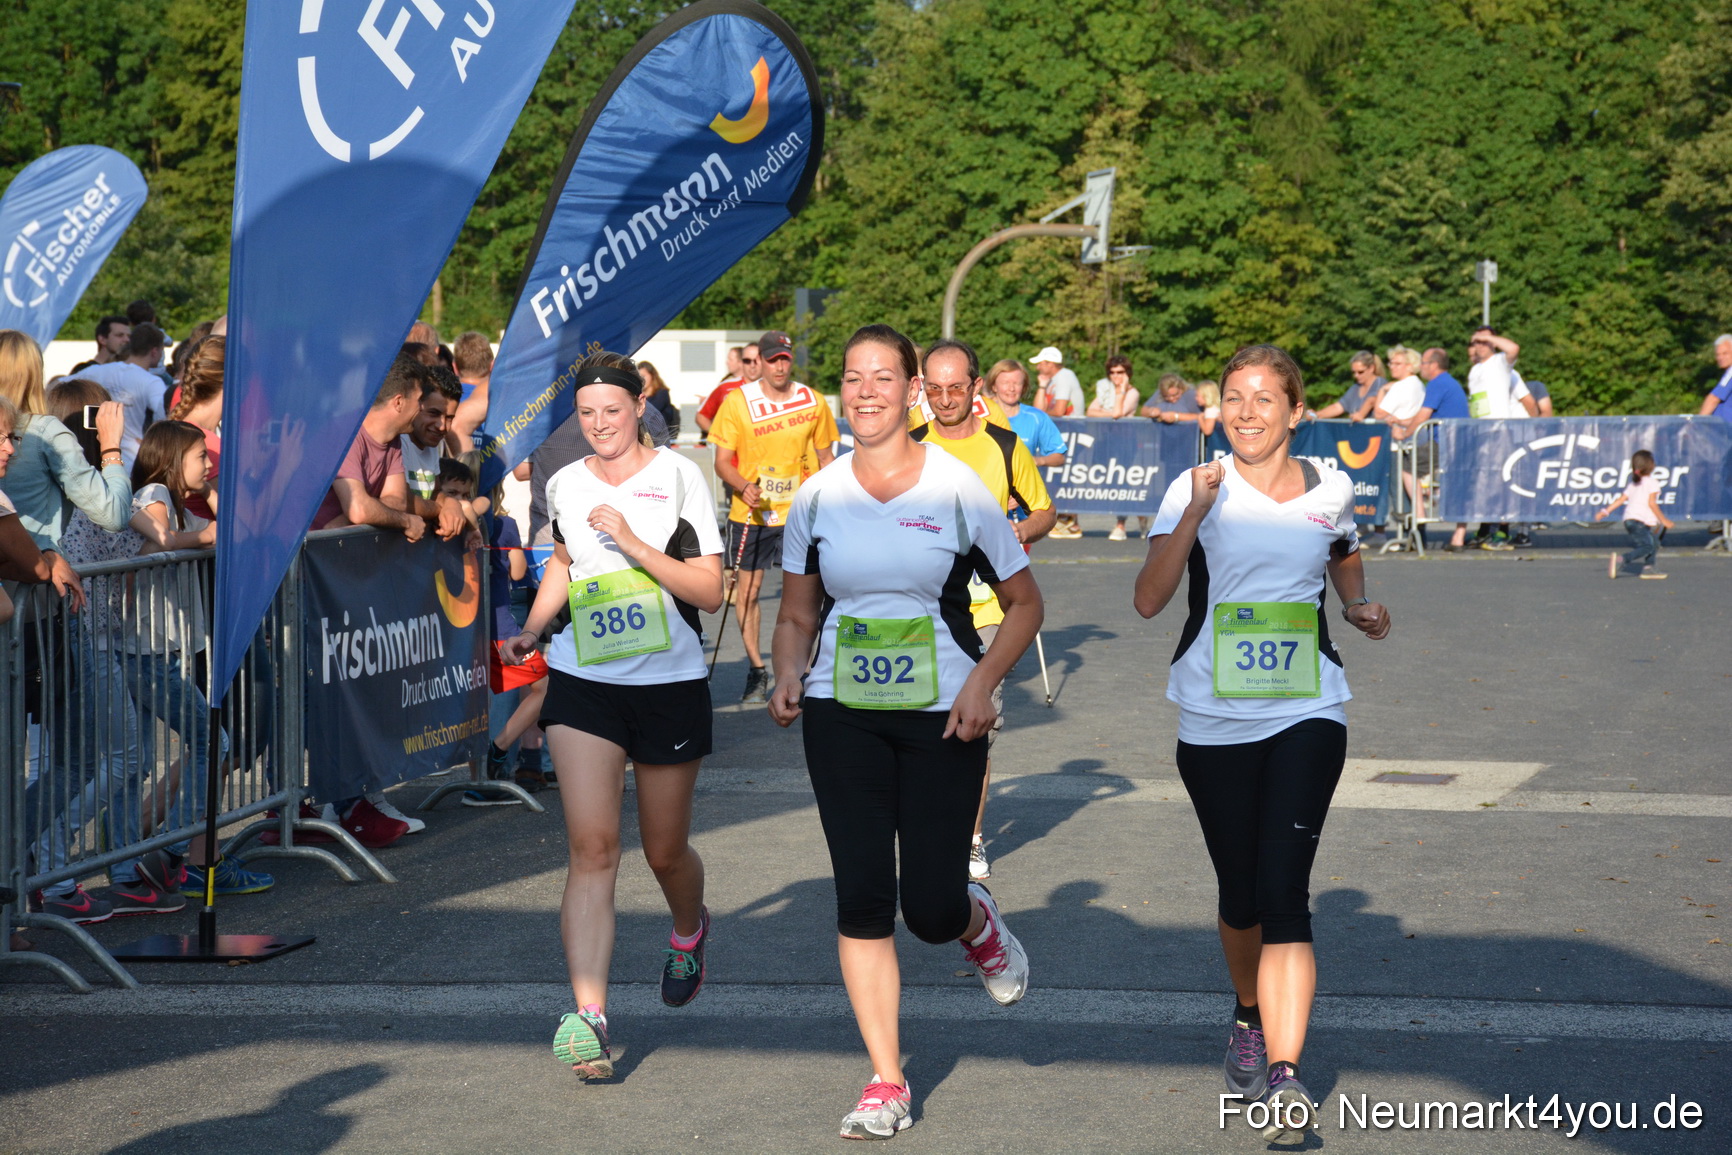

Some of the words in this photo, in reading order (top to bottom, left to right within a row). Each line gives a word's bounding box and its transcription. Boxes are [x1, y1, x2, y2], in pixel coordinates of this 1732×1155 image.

[660, 212, 710, 262] Druck
[743, 131, 804, 196] Medien
[25, 172, 111, 288] Fischer
[57, 194, 120, 287] AUTOMOBILE
[530, 153, 733, 339] Frischmann
[753, 420, 785, 438] MAX
[766, 479, 792, 494] 864
[1046, 458, 1158, 486] Fischer
[1055, 487, 1148, 502] AUTOMOBILE
[1550, 492, 1677, 505] AUTOMLE
[906, 522, 943, 531] partner
[590, 603, 646, 638] 386
[321, 606, 444, 684] Frischmann
[616, 637, 640, 647] Wieland
[1236, 640, 1298, 671] 387
[401, 672, 427, 708] Druck
[428, 667, 453, 701] und
[452, 659, 487, 694] Medien
[852, 655, 915, 685] 392
[1246, 677, 1271, 685] Brigitte
[403, 712, 488, 755] www.frischmann-net.de
